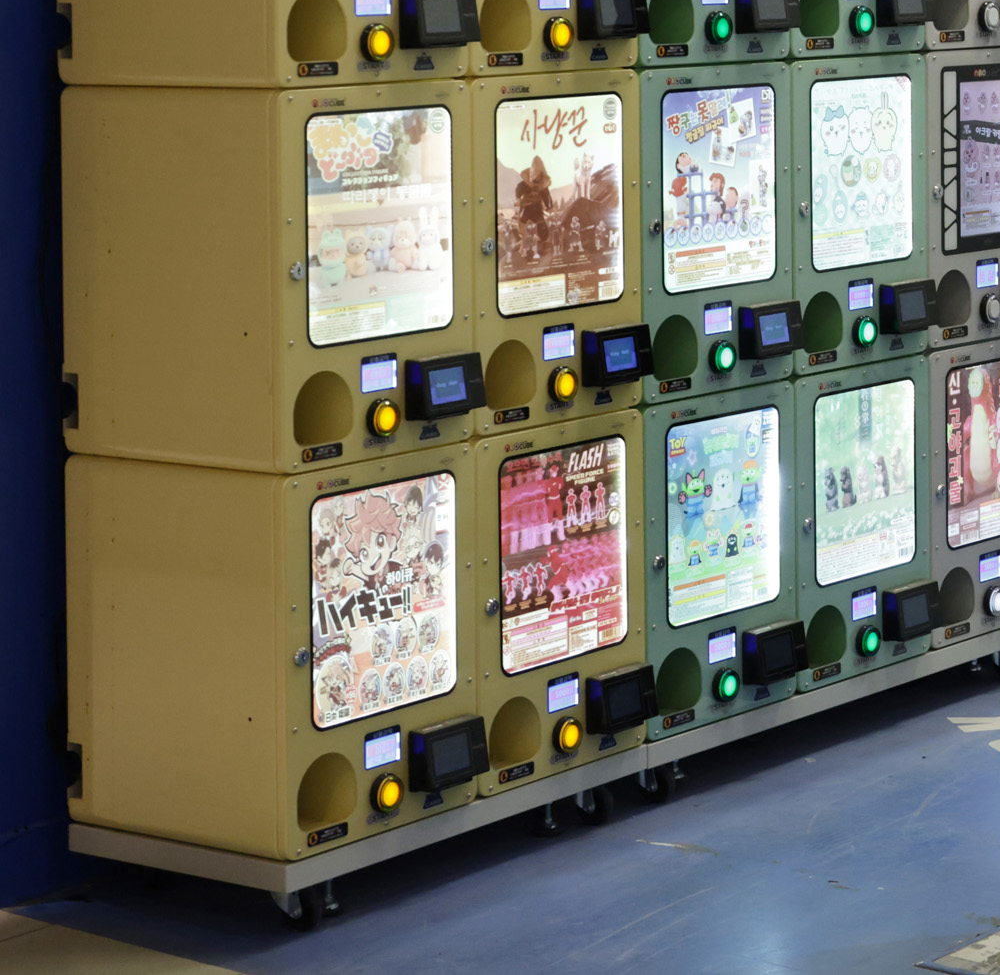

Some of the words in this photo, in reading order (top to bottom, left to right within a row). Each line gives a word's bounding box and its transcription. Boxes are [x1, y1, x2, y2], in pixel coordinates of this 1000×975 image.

[521, 106, 588, 150] 사냥꾼
[342, 174, 398, 186] コレクションフィギュア
[549, 401, 569, 410] START
[369, 437, 389, 446] START
[669, 436, 687, 450] TOY
[568, 443, 604, 473] FLASH
[565, 473, 585, 483] SPEED
[585, 468, 604, 478] FORCE
[574, 476, 596, 486] FIGURE
[386, 567, 414, 586] 하이큐
[316, 585, 413, 638] ハイキュー!!
